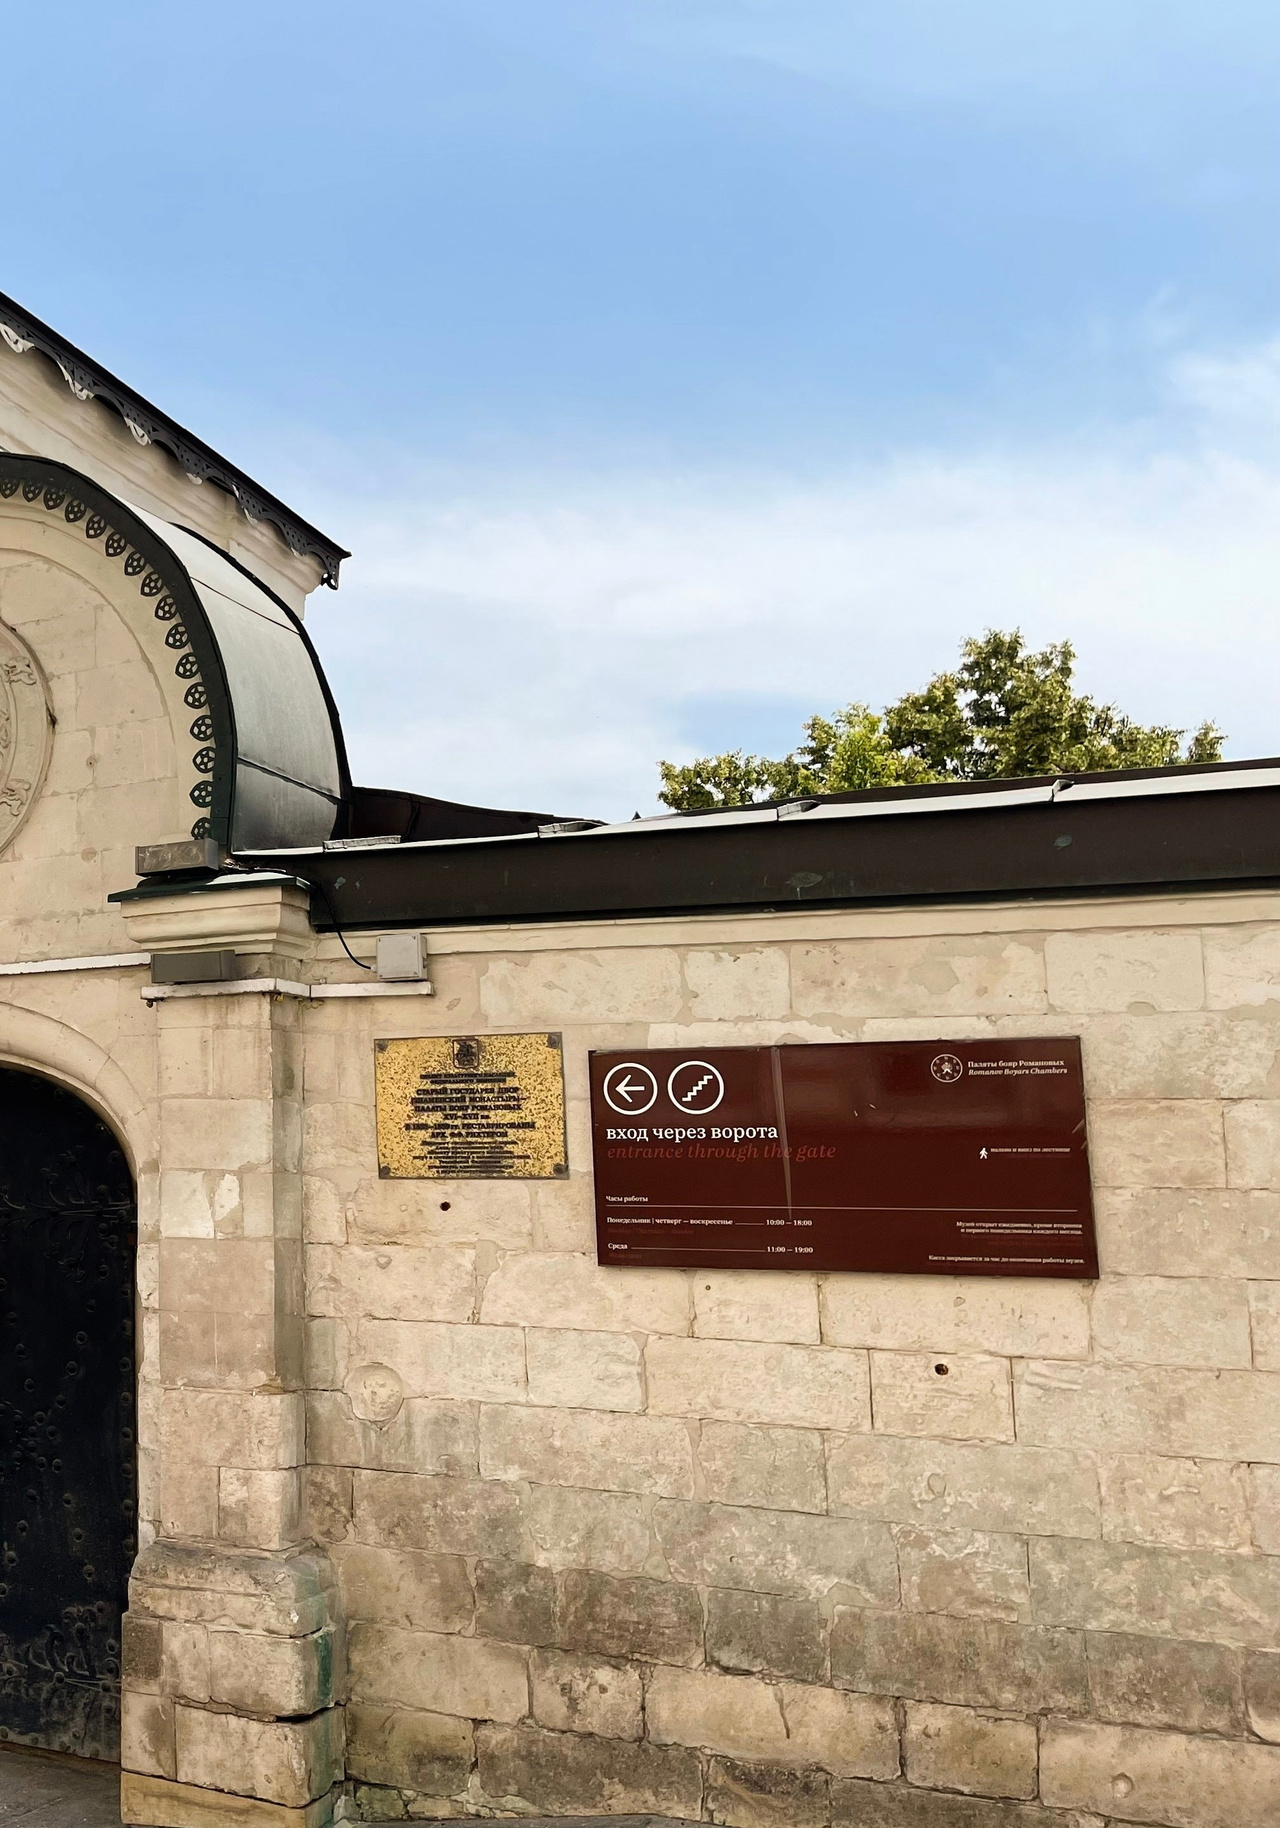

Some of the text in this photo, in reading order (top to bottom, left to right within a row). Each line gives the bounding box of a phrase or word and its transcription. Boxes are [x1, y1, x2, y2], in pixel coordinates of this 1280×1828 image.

[999, 1060, 1018, 1068] бояр
[1004, 1068, 1029, 1076] Boyars
[606, 1126, 778, 1143] вход через ворота
[608, 1142, 836, 1164] entrance through the gate
[624, 1195, 648, 1203] работы
[607, 1217, 651, 1225] Понедельник
[655, 1218, 682, 1226] четверг
